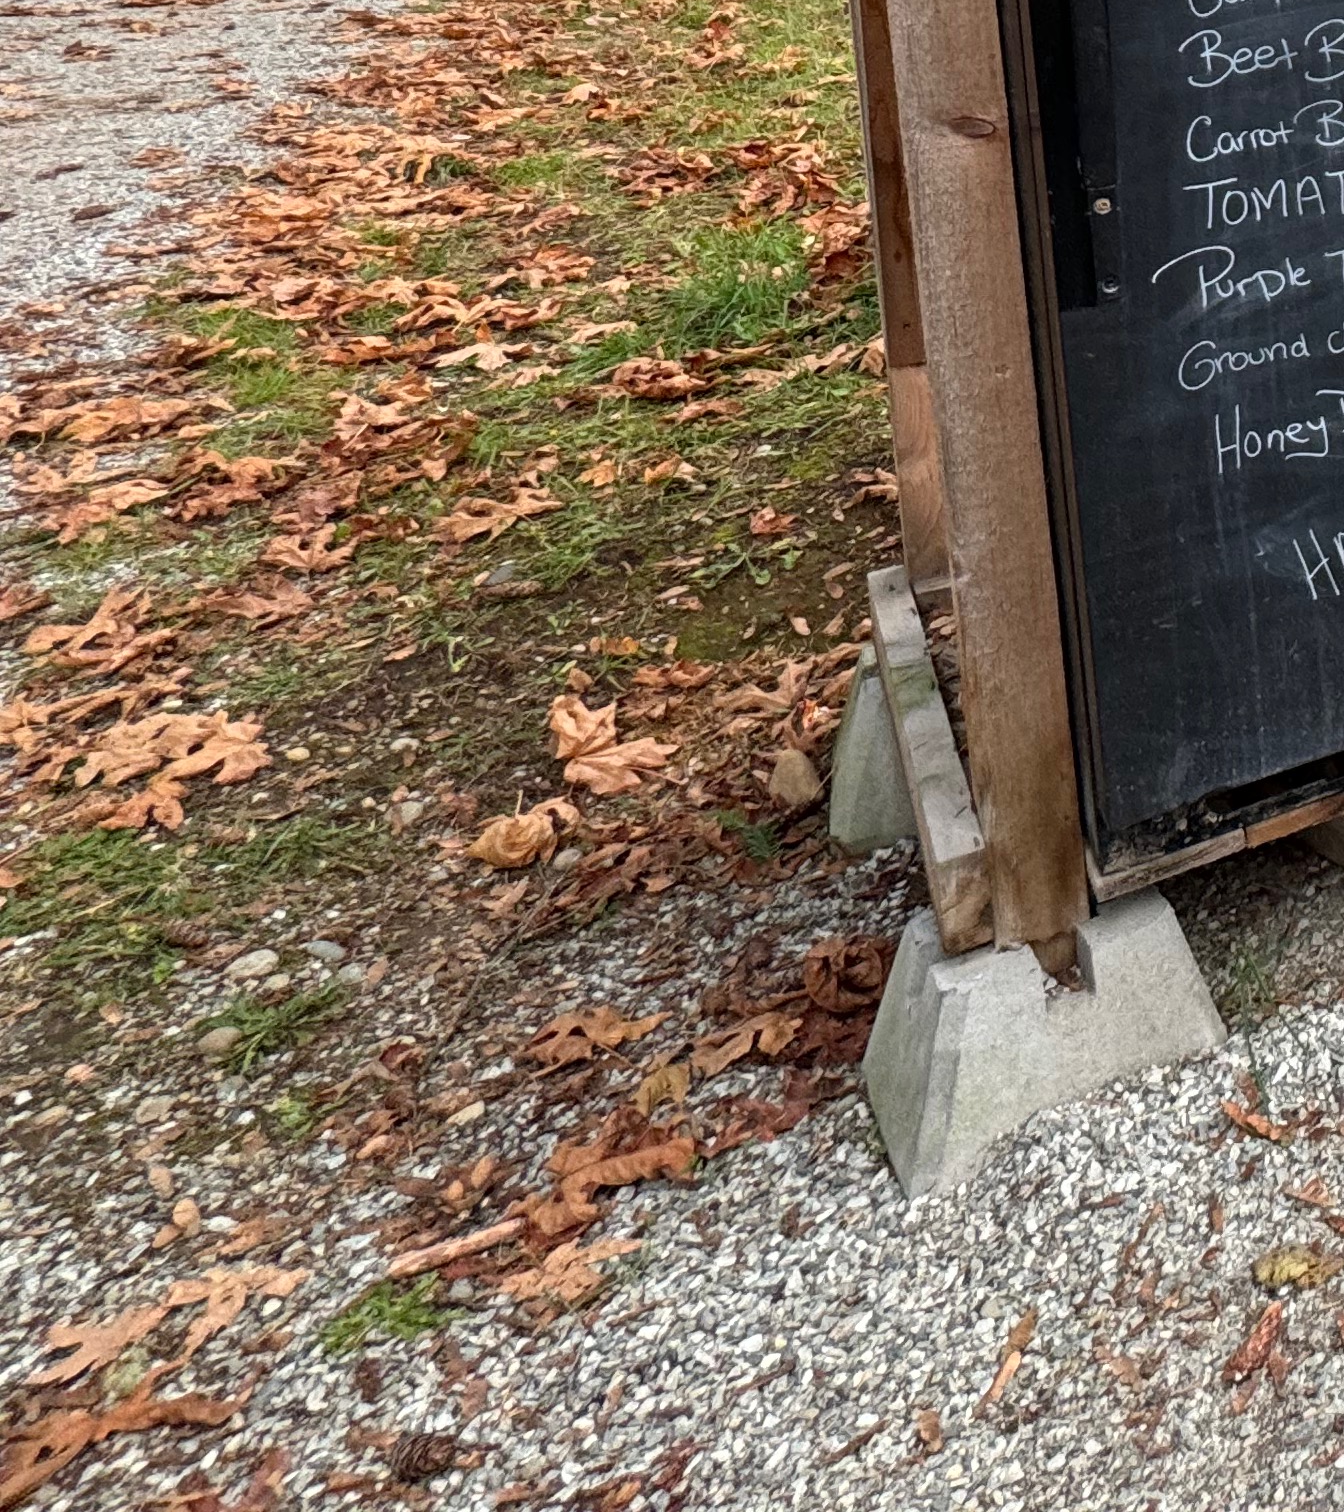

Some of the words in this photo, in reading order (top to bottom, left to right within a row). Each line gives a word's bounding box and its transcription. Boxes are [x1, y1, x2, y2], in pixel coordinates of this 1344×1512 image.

[1178, 29, 1299, 88] Beet
[1186, 114, 1295, 162] Carrot
[1152, 245, 1312, 309] Purple
[1178, 336, 1309, 390] Ground
[1214, 403, 1329, 474] Honey
